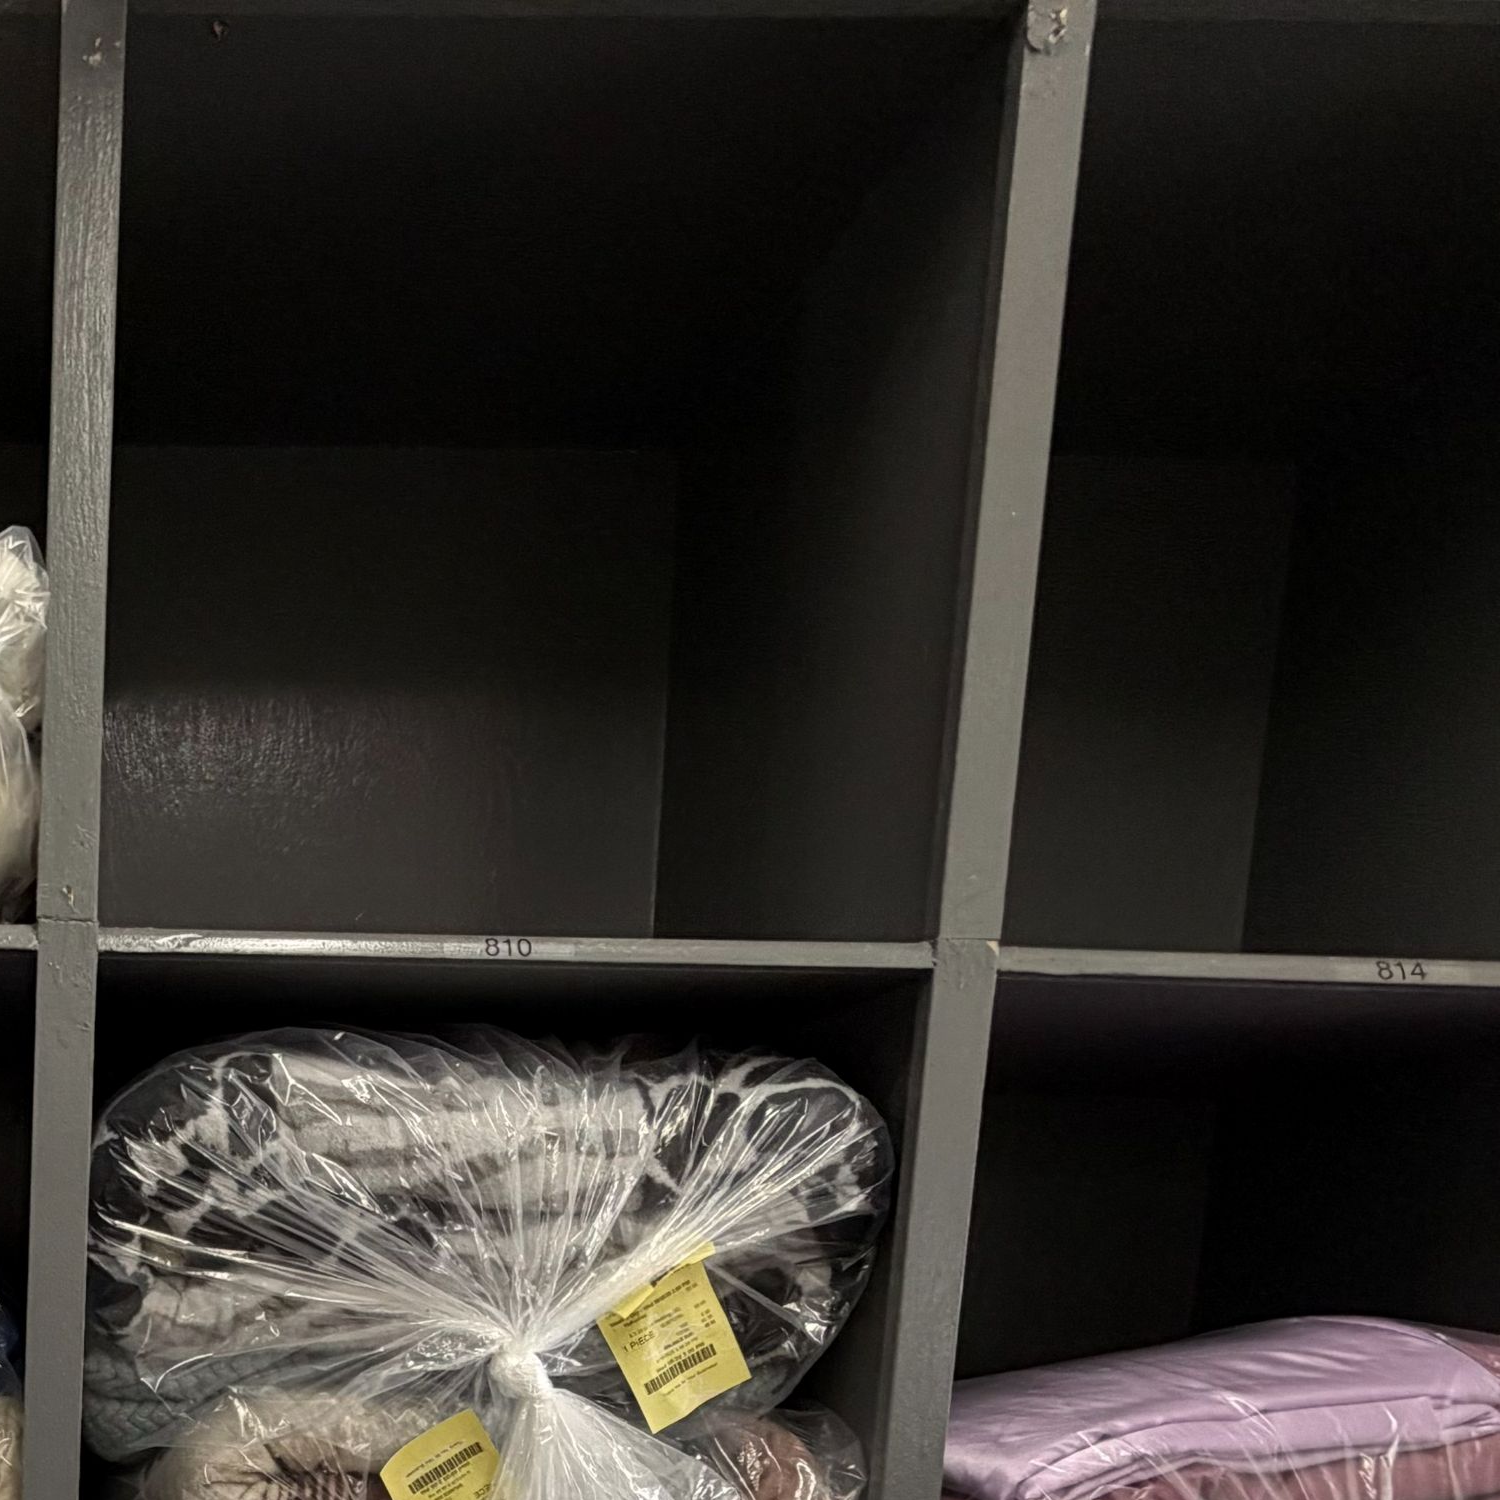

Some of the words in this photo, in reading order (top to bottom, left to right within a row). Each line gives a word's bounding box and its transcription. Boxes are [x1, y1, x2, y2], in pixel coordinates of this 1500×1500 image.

[485, 938, 532, 957] 810
[1376, 960, 1428, 980] 814
[629, 1331, 655, 1350] PIECE
